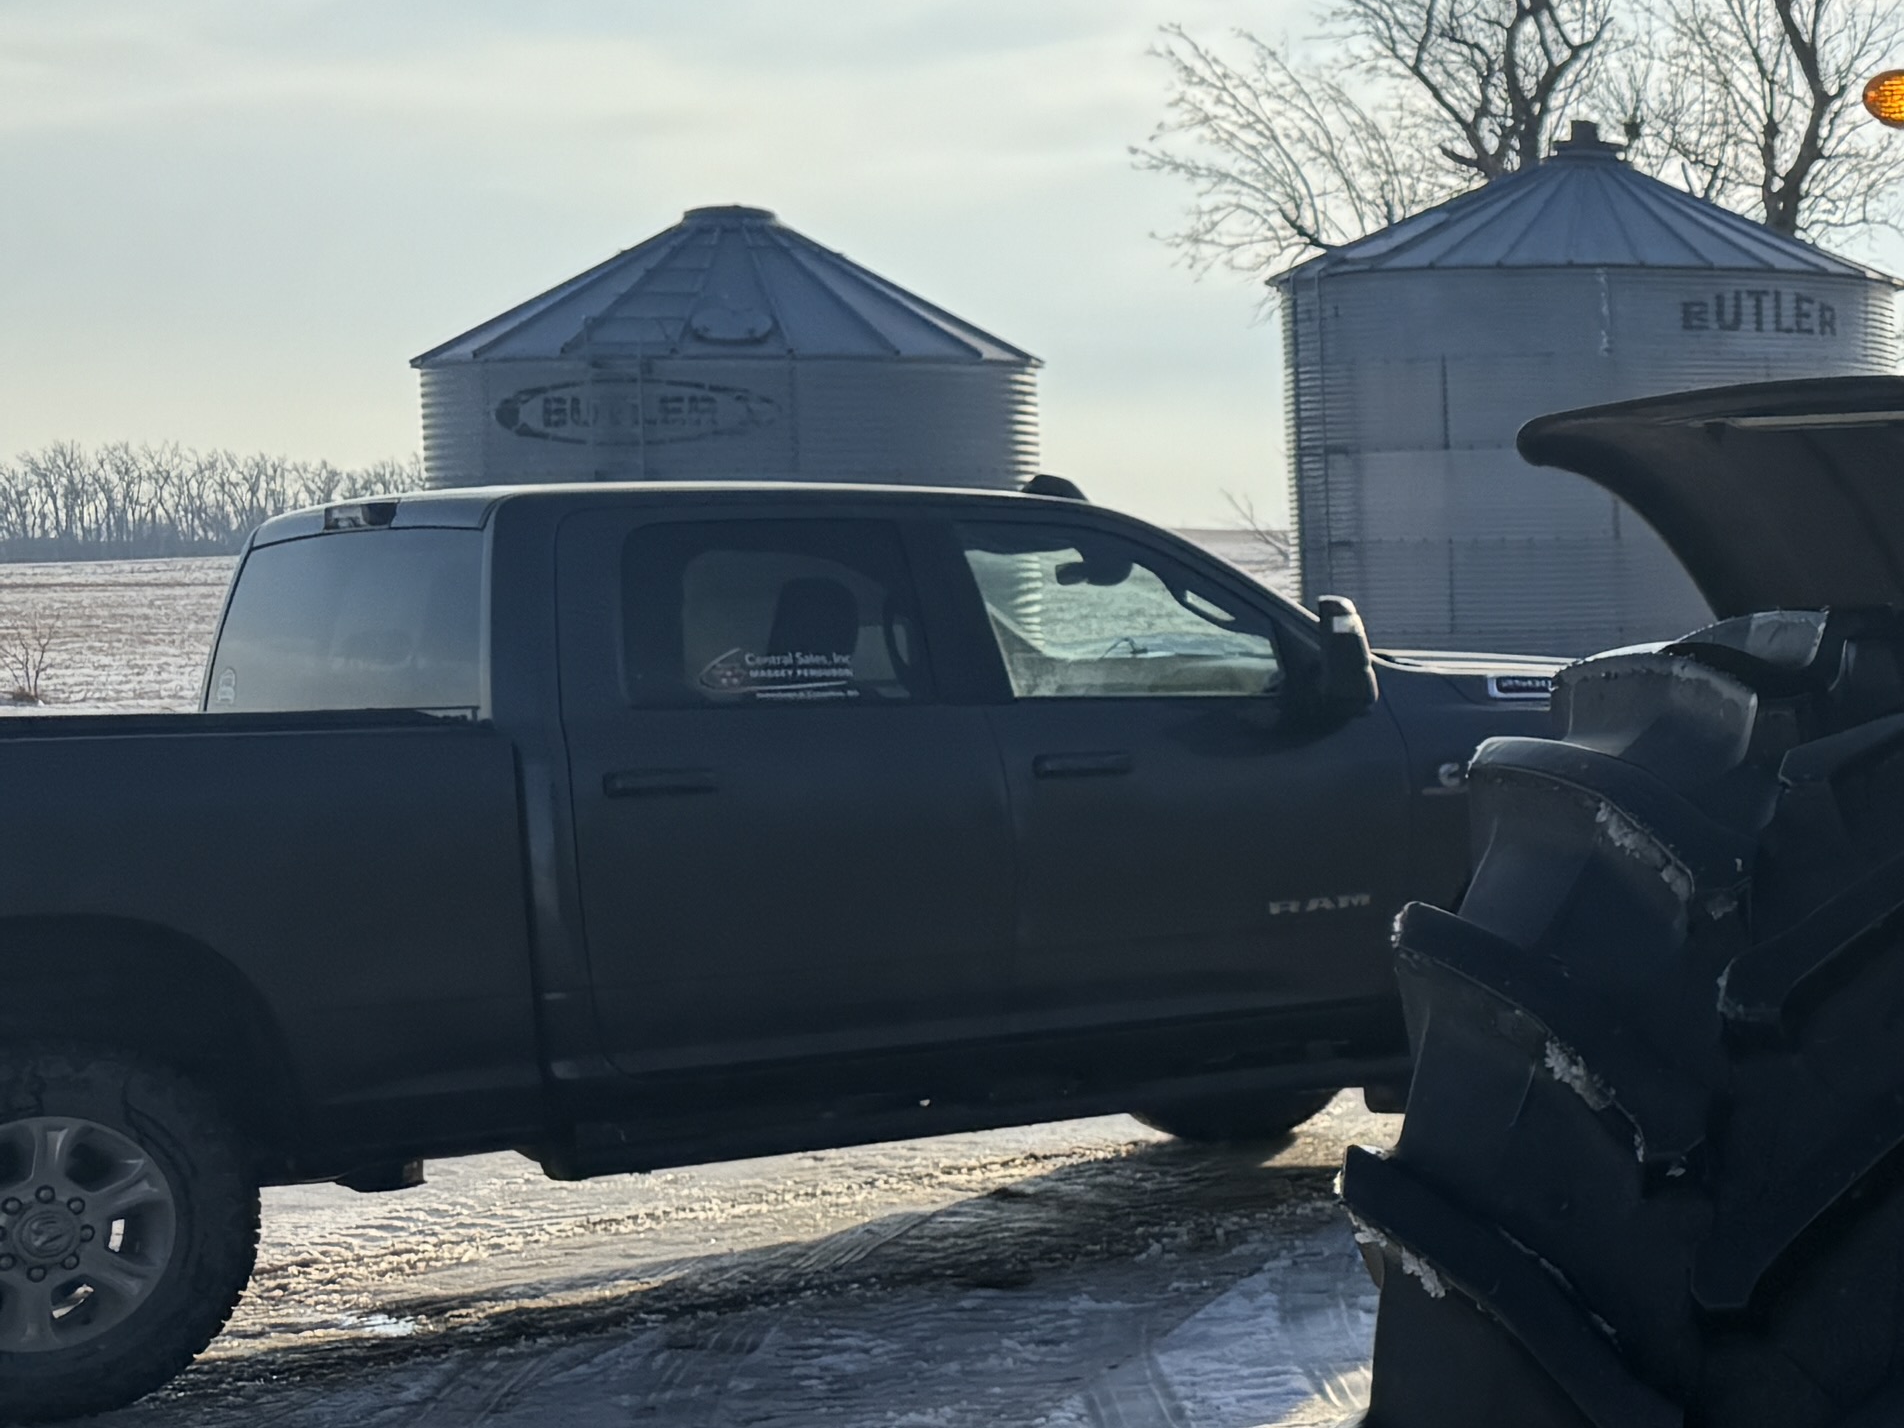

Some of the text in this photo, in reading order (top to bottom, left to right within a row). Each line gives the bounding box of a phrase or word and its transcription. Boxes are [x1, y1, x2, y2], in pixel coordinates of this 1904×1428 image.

[1681, 290, 1836, 336] BUTLER
[744, 651, 793, 666] Central
[1268, 893, 1370, 915] RAM
